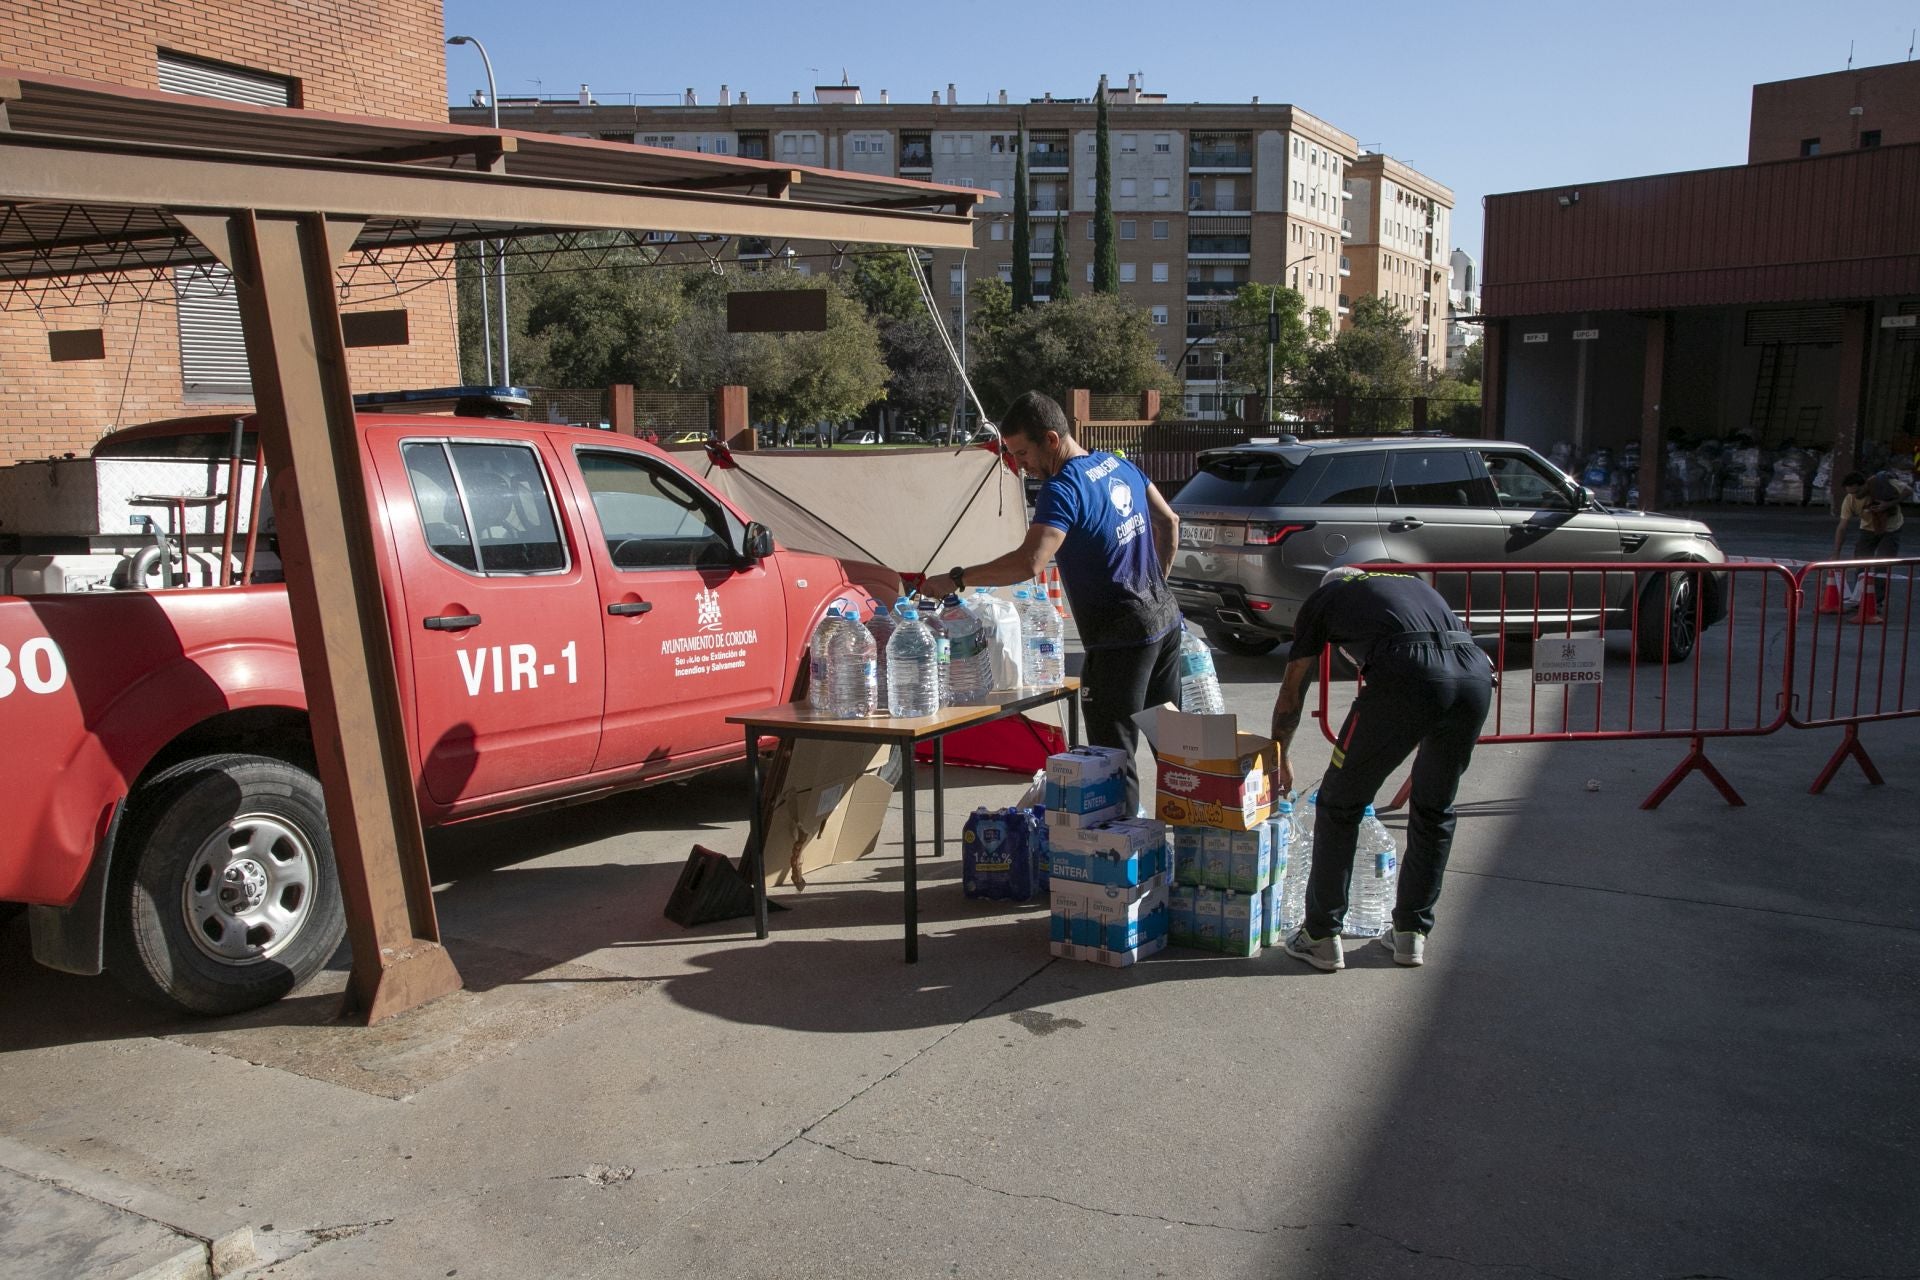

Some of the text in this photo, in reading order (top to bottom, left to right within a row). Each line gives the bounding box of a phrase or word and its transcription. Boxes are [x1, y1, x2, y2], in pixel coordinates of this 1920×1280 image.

[661, 630, 758, 655] AYUNTAMIENTO DE CORDOBA
[710, 650, 737, 660] Extinción
[738, 648, 746, 657] de
[456, 640, 578, 697] VIR-1
[675, 659, 746, 677] Incendios y Salvamento
[1535, 671, 1601, 682] BOMBEROS
[1083, 795, 1107, 810] ENTERA
[1053, 864, 1089, 880] ENTERA
